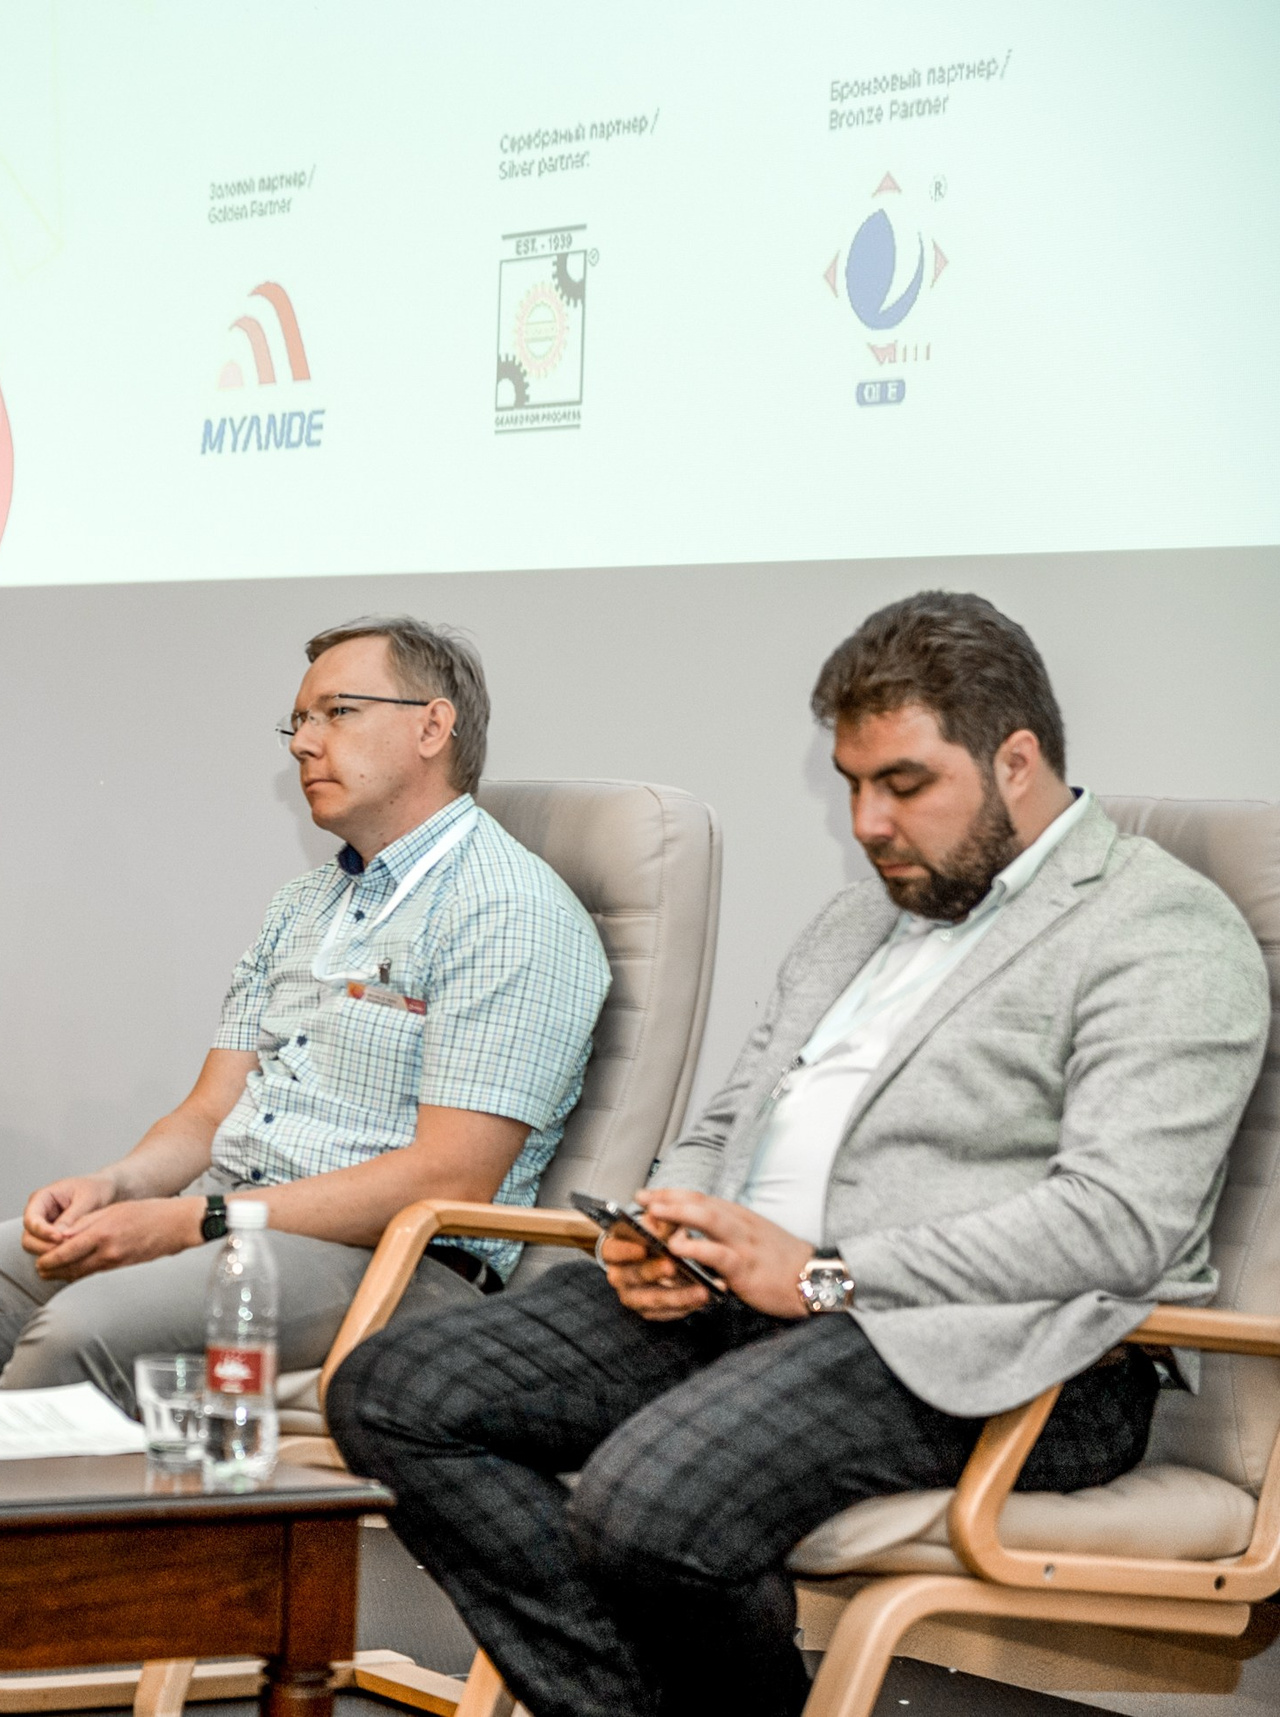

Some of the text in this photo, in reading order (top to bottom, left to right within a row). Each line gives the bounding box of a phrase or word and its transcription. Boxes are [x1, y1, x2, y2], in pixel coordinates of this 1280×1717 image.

[830, 68, 921, 103] Бронзовый
[927, 57, 999, 87] партнер
[829, 94, 949, 131] Bronze Partner
[589, 115, 649, 141] партнер
[258, 170, 307, 194] партнер
[499, 158, 534, 180] Silver
[208, 197, 293, 224] Golden Partner
[548, 233, 573, 251] 1939
[200, 409, 326, 455] MYANDE
